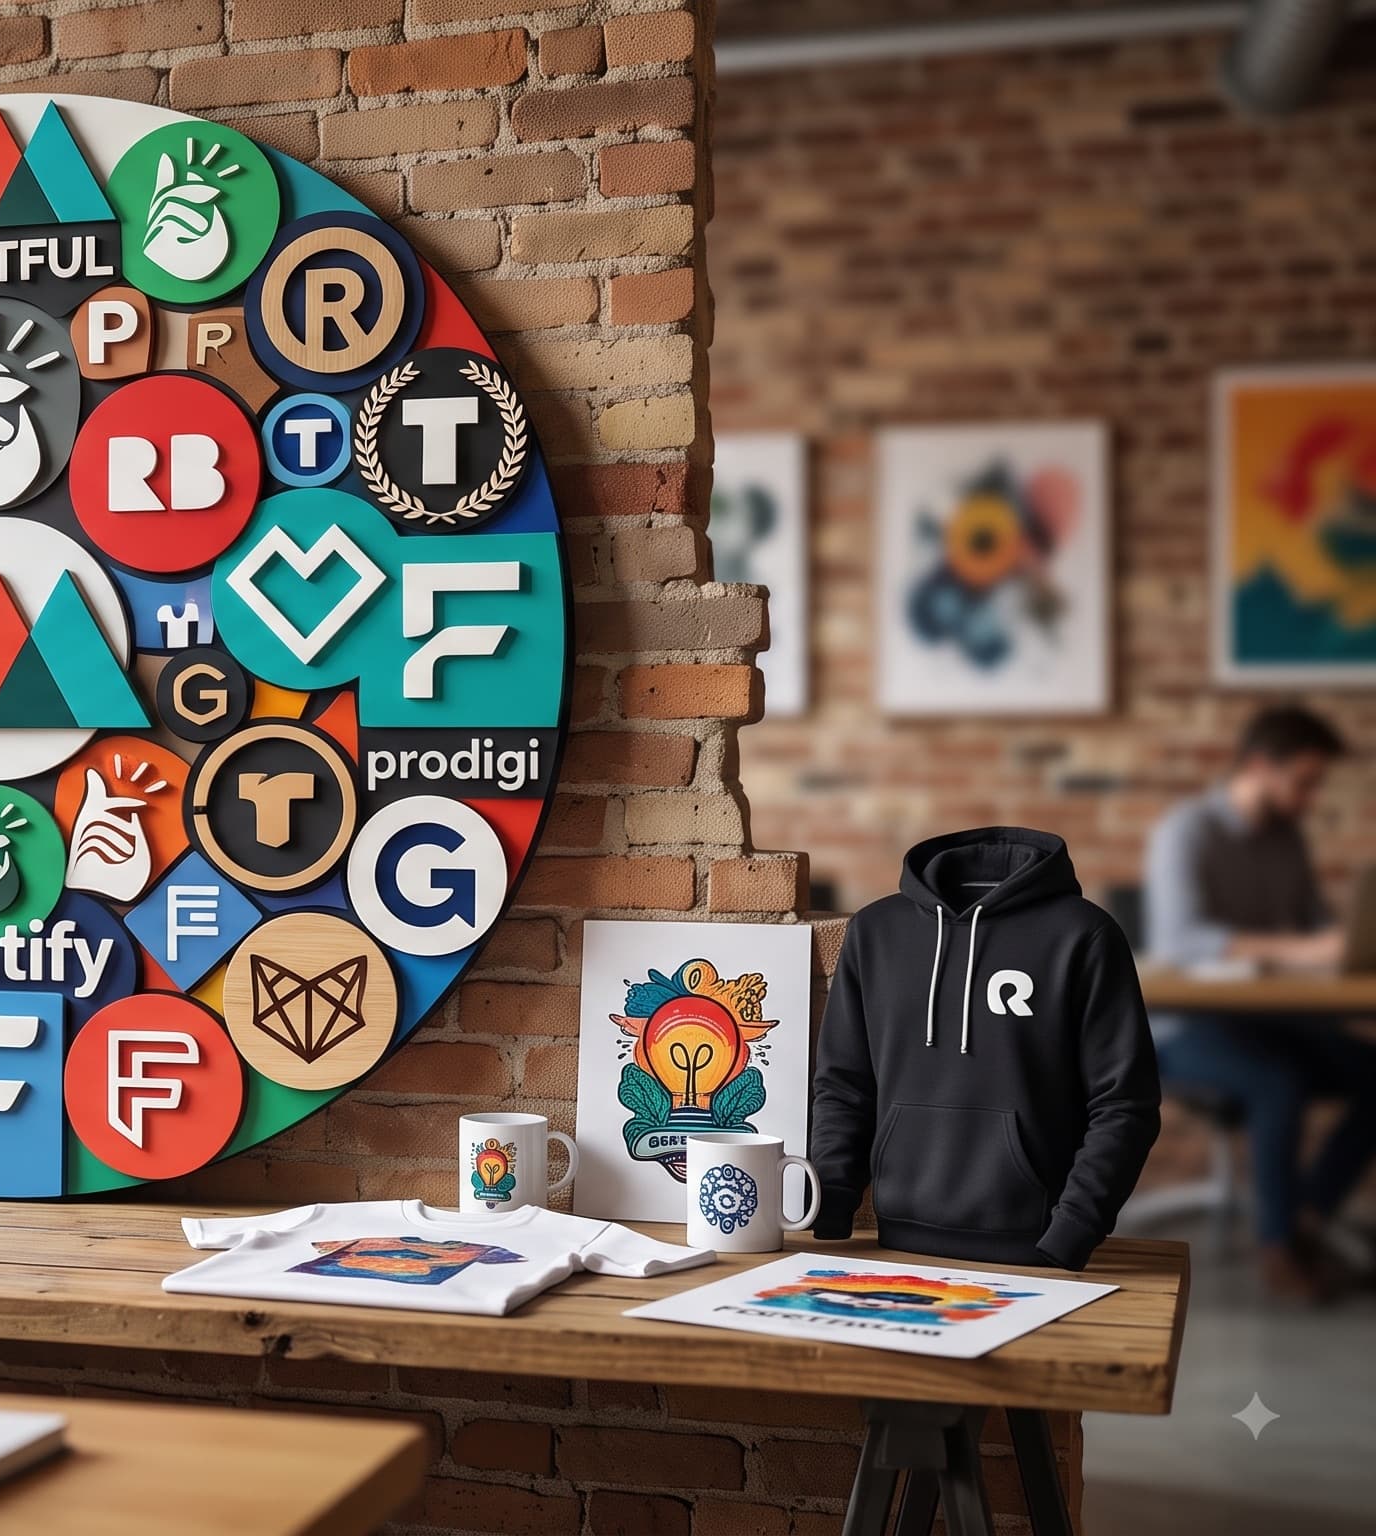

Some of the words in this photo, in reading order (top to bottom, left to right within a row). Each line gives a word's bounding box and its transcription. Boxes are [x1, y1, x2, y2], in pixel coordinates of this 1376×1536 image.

[88, 301, 138, 364] P
[196, 322, 232, 366] R
[108, 434, 226, 511] RB
[284, 418, 333, 468] T
[402, 397, 478, 485] T
[403, 561, 521, 699] F
[172, 663, 228, 727] G
[367, 738, 539, 791] prodigi
[374, 822, 477, 929] G
[986, 969, 1034, 1017] R
[108, 1030, 201, 1149] F
